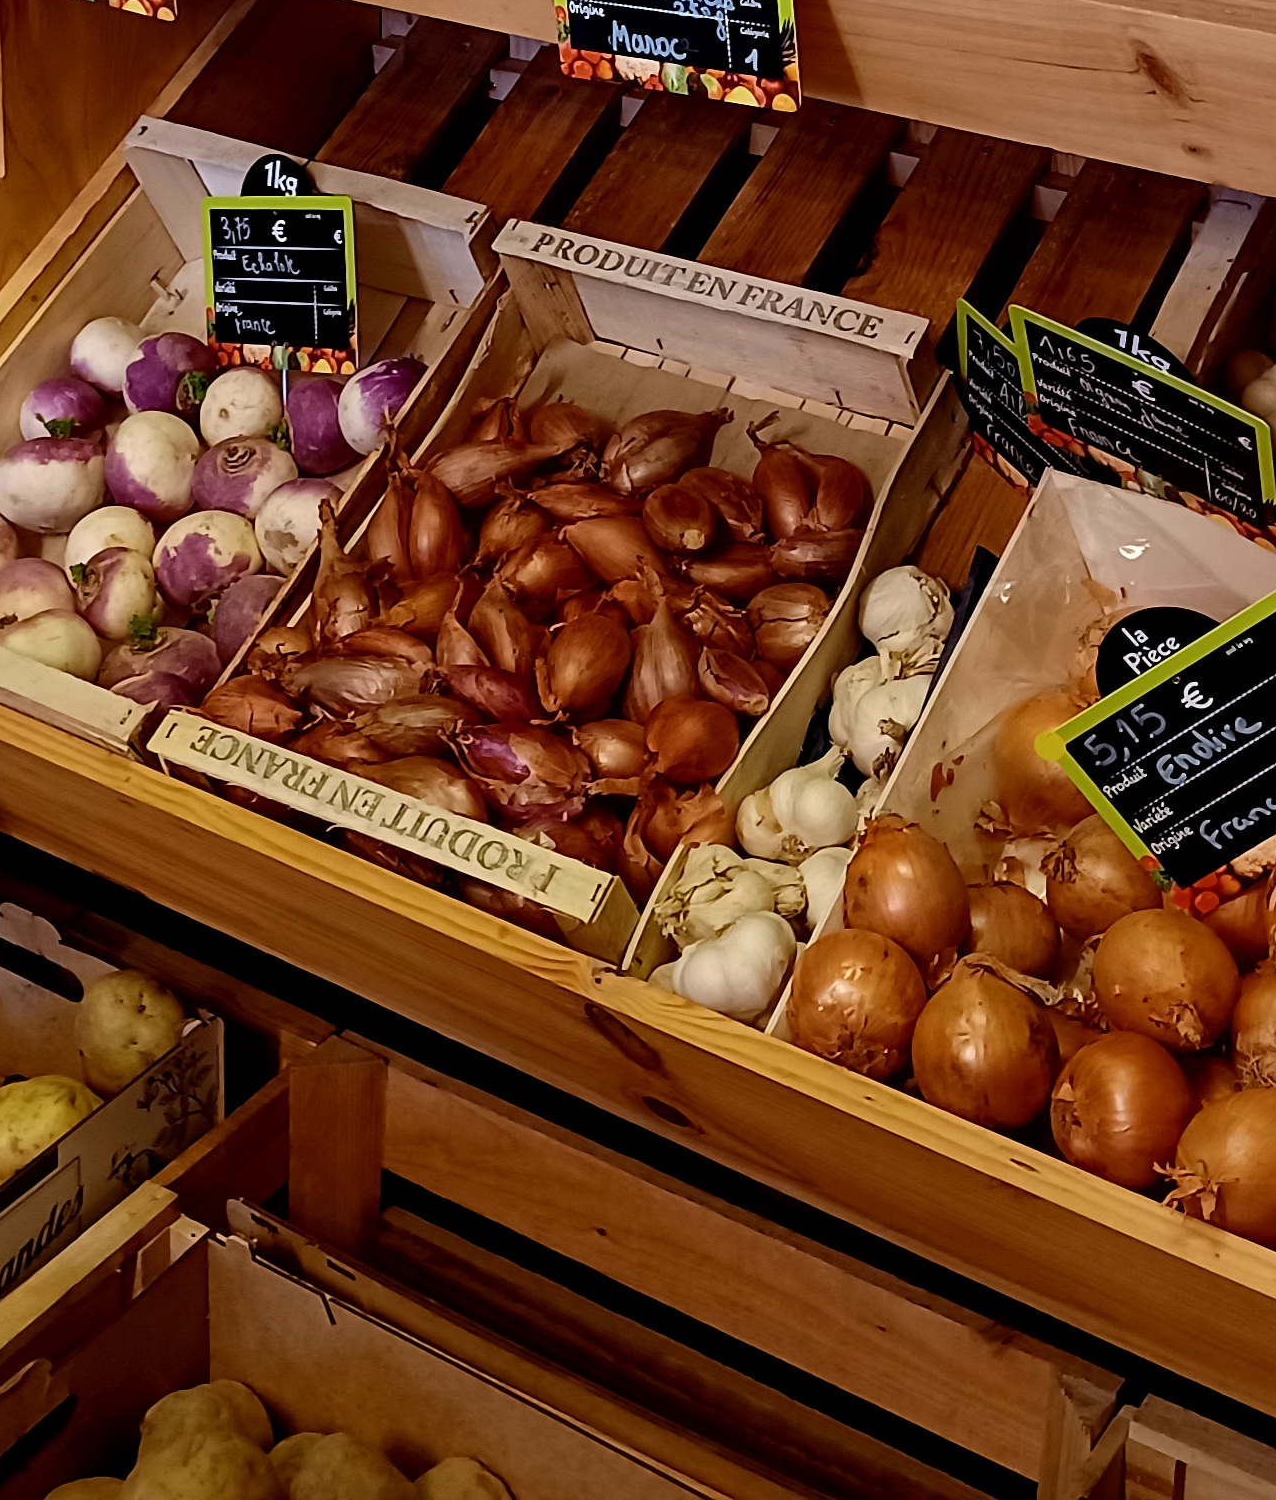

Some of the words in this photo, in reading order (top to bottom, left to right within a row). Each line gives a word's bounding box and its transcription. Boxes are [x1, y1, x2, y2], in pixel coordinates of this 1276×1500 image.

[569, 0, 605, 19] Origine
[608, 20, 687, 60] Maroc
[264, 160, 298, 197] 1kg
[221, 217, 251, 244] 3,75
[272, 220, 287, 242] €
[530, 232, 687, 286] PRODUIT
[684, 270, 738, 301] EN
[736, 283, 884, 339] FRANCE
[1122, 627, 1148, 647] la
[1123, 635, 1181, 675] Pièce
[1083, 703, 1167, 767] 5,15
[1180, 681, 1213, 710] €
[190, 725, 330, 798] FRANCE
[1155, 716, 1263, 785] Endive
[325, 780, 385, 820] EN
[1102, 766, 1147, 799] Produit
[1132, 802, 1175, 834] Variété
[379, 801, 562, 897] PRODUIT
[1150, 825, 1194, 855] Origine
